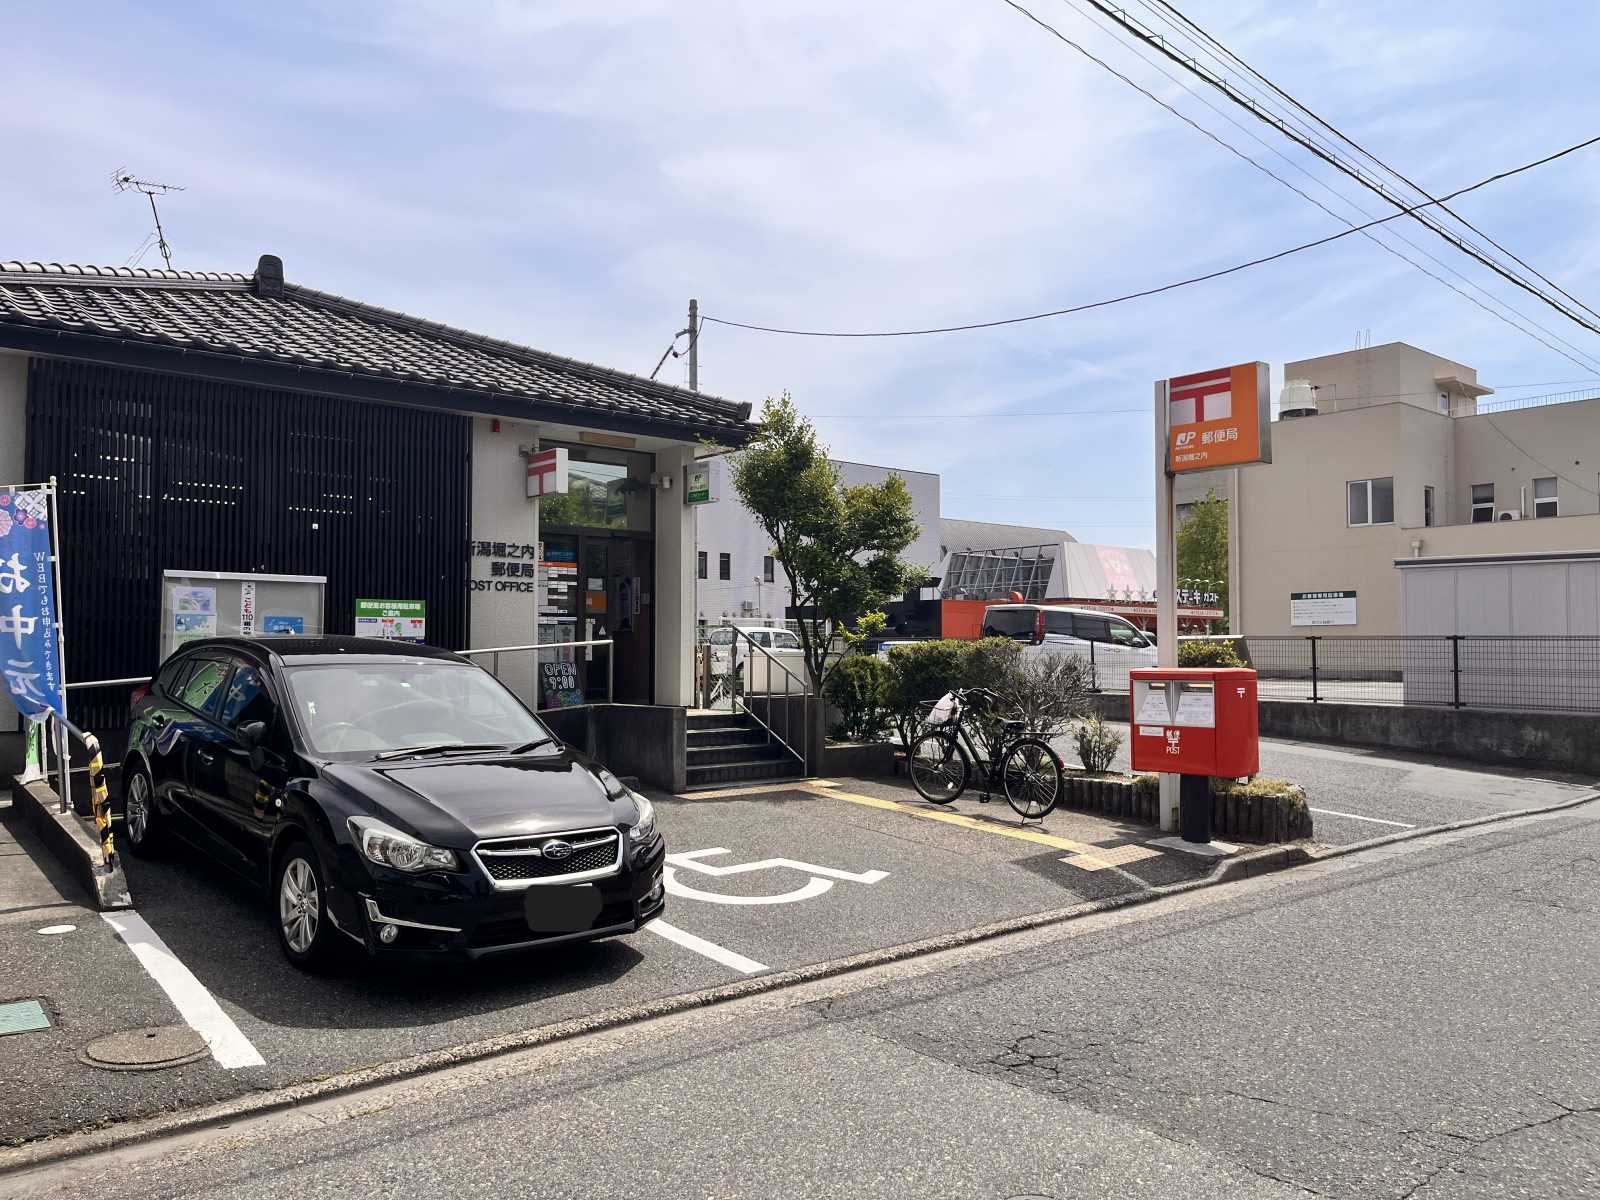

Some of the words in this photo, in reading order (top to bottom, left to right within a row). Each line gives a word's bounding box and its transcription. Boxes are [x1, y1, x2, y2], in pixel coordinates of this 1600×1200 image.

[1201, 428, 1239, 445] 郵便局
[491, 561, 535, 578] 郵便局
[469, 579, 494, 592] OST
[494, 580, 535, 593] OFFICE
[544, 662, 577, 676] OPEN
[549, 675, 576, 690] 9:00
[1166, 746, 1180, 755] POST
